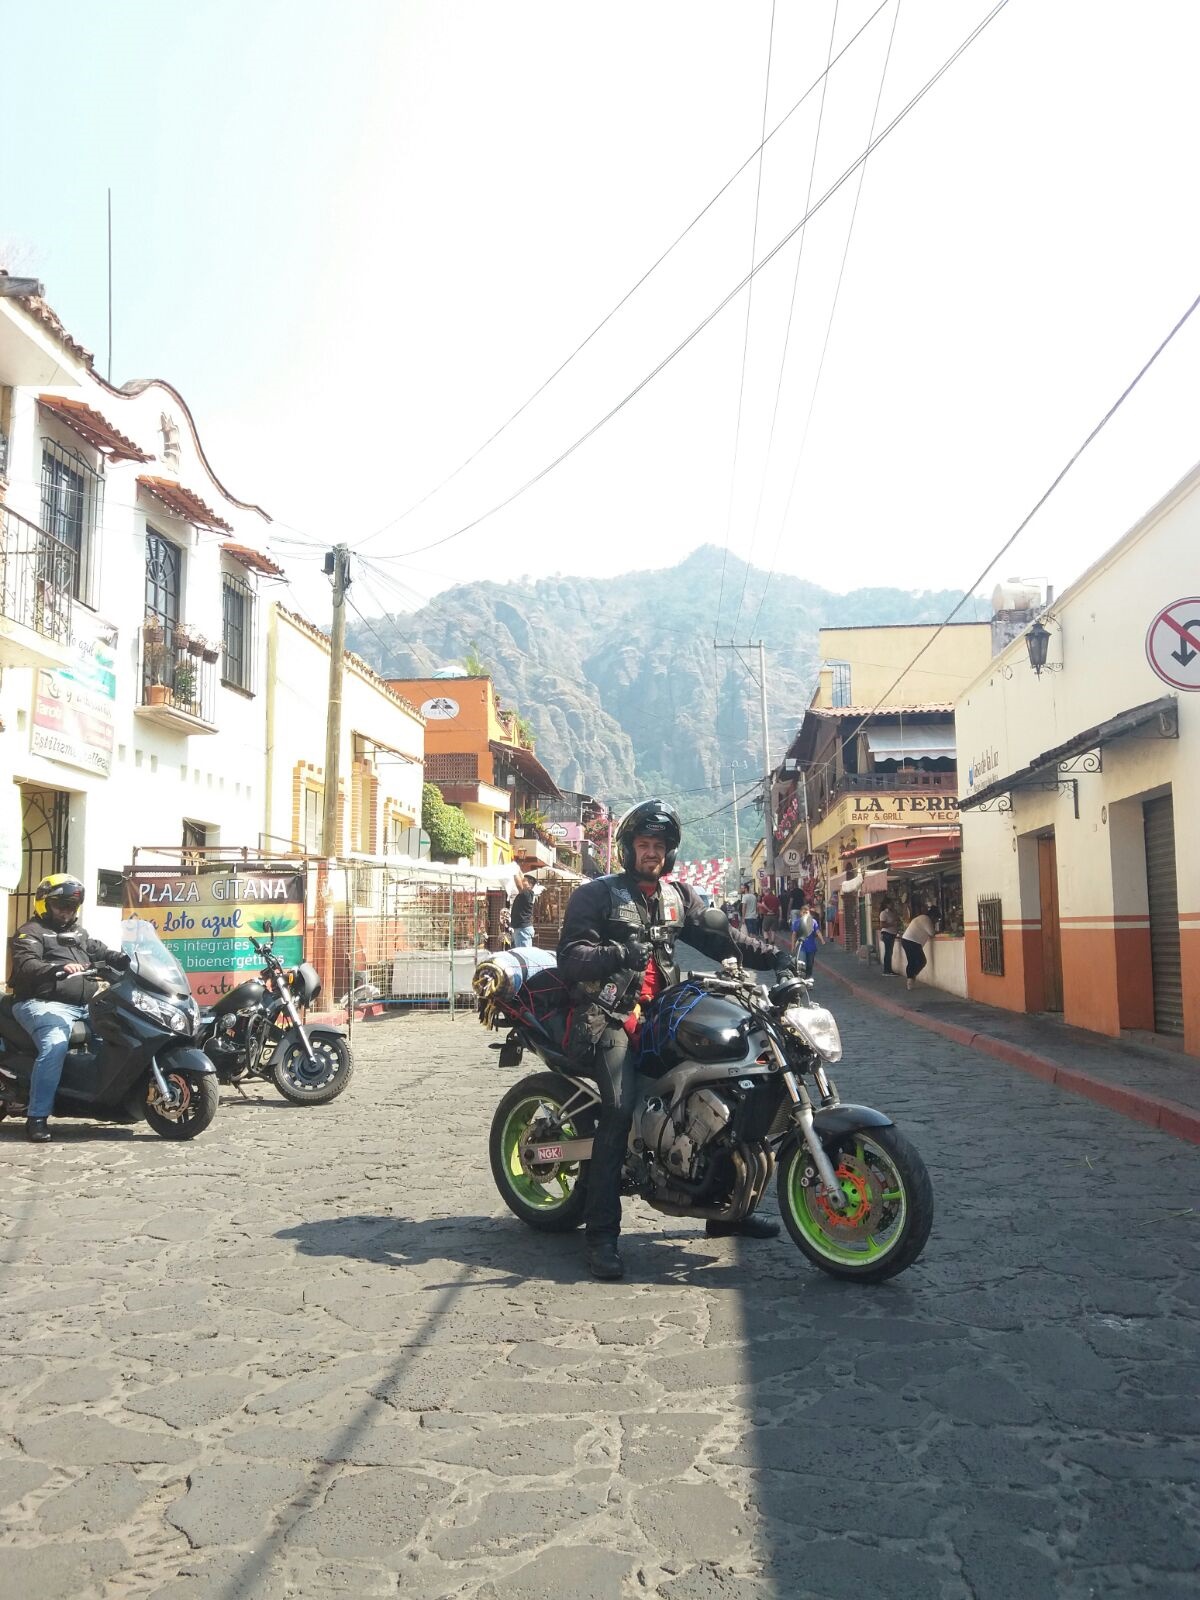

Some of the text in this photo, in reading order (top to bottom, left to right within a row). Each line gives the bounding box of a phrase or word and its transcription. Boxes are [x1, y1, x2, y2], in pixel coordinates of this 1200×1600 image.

[34, 732, 75, 757] Estilizm
[854, 796, 960, 812] LA TERR
[883, 812, 904, 820] GRILL
[138, 878, 288, 902] PLAZA GITANA
[163, 910, 195, 932] Loto
[201, 908, 243, 937] azul
[183, 940, 250, 954] integrales
[187, 953, 285, 969] bioenergétis
[540, 1148, 558, 1158] NGK
